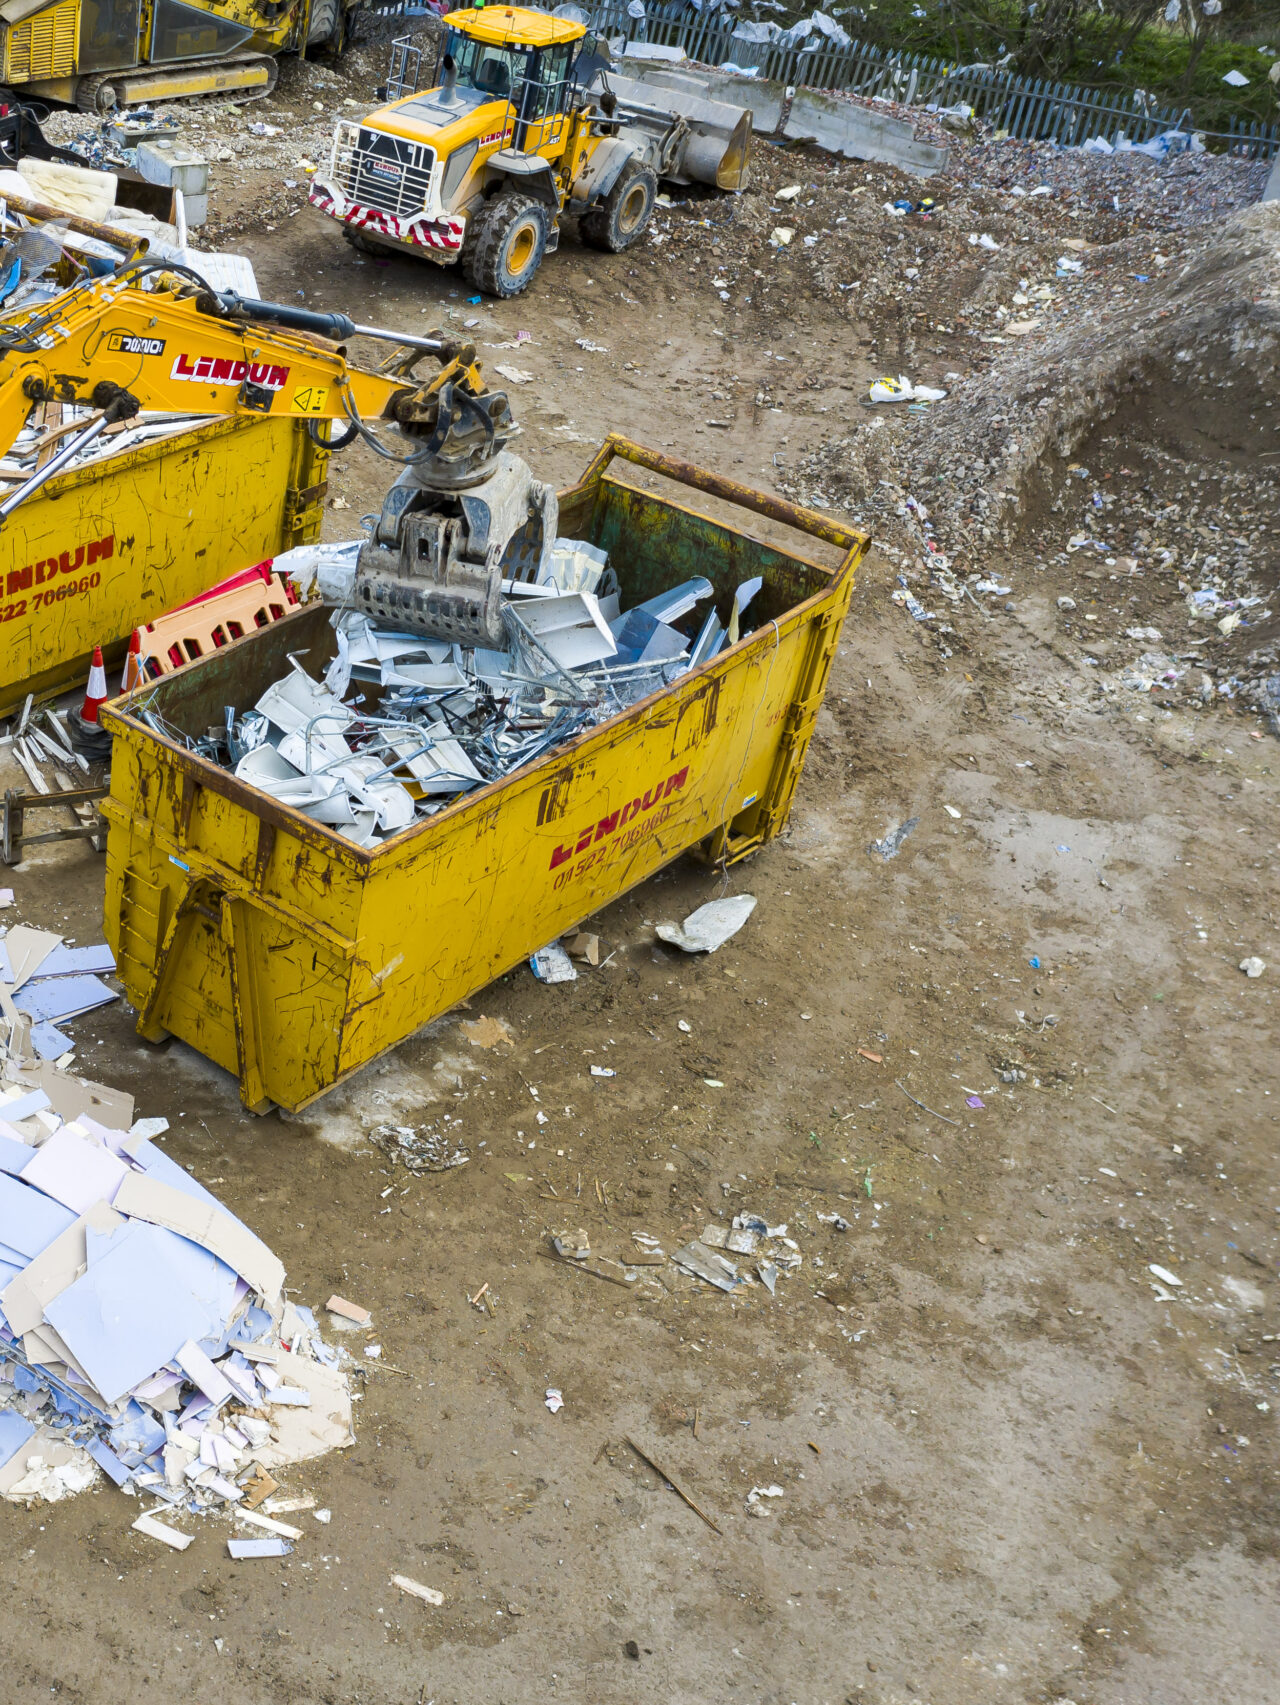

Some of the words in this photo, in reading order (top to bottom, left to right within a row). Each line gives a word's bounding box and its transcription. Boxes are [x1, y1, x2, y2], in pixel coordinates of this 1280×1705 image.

[479, 127, 513, 147] LINDM
[170, 353, 291, 391] LINDUM
[32, 571, 101, 611] 706960
[548, 764, 690, 872] LINDUM
